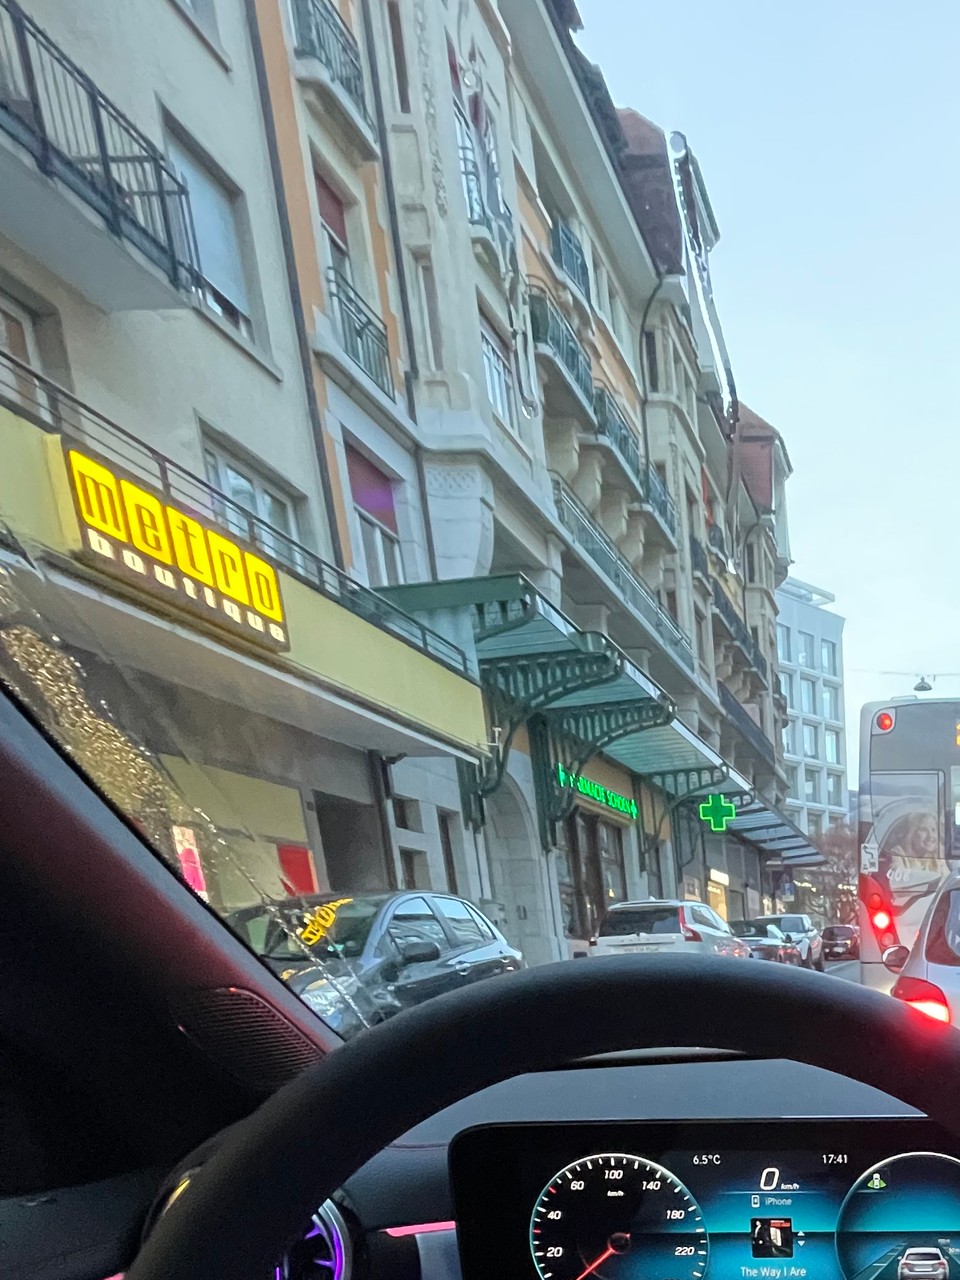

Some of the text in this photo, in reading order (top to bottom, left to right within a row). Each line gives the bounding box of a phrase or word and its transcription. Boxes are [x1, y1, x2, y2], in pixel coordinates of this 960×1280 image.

[72, 458, 280, 618] metro
[87, 528, 286, 643] boutique
[693, 1154, 721, 1165] 6.5°C
[822, 1154, 848, 1164] 17:41
[604, 1170, 623, 1179] 100
[760, 1167, 780, 1190] 0
[570, 1181, 584, 1190] 60
[642, 1181, 661, 1190] 140
[765, 1197, 792, 1205] iPhone
[547, 1210, 561, 1219] 40
[666, 1210, 684, 1219] 180
[546, 1247, 563, 1257] 20
[675, 1246, 694, 1256] 220
[740, 1266, 758, 1276] The
[761, 1266, 781, 1279] Way
[790, 1266, 806, 1276] Are
